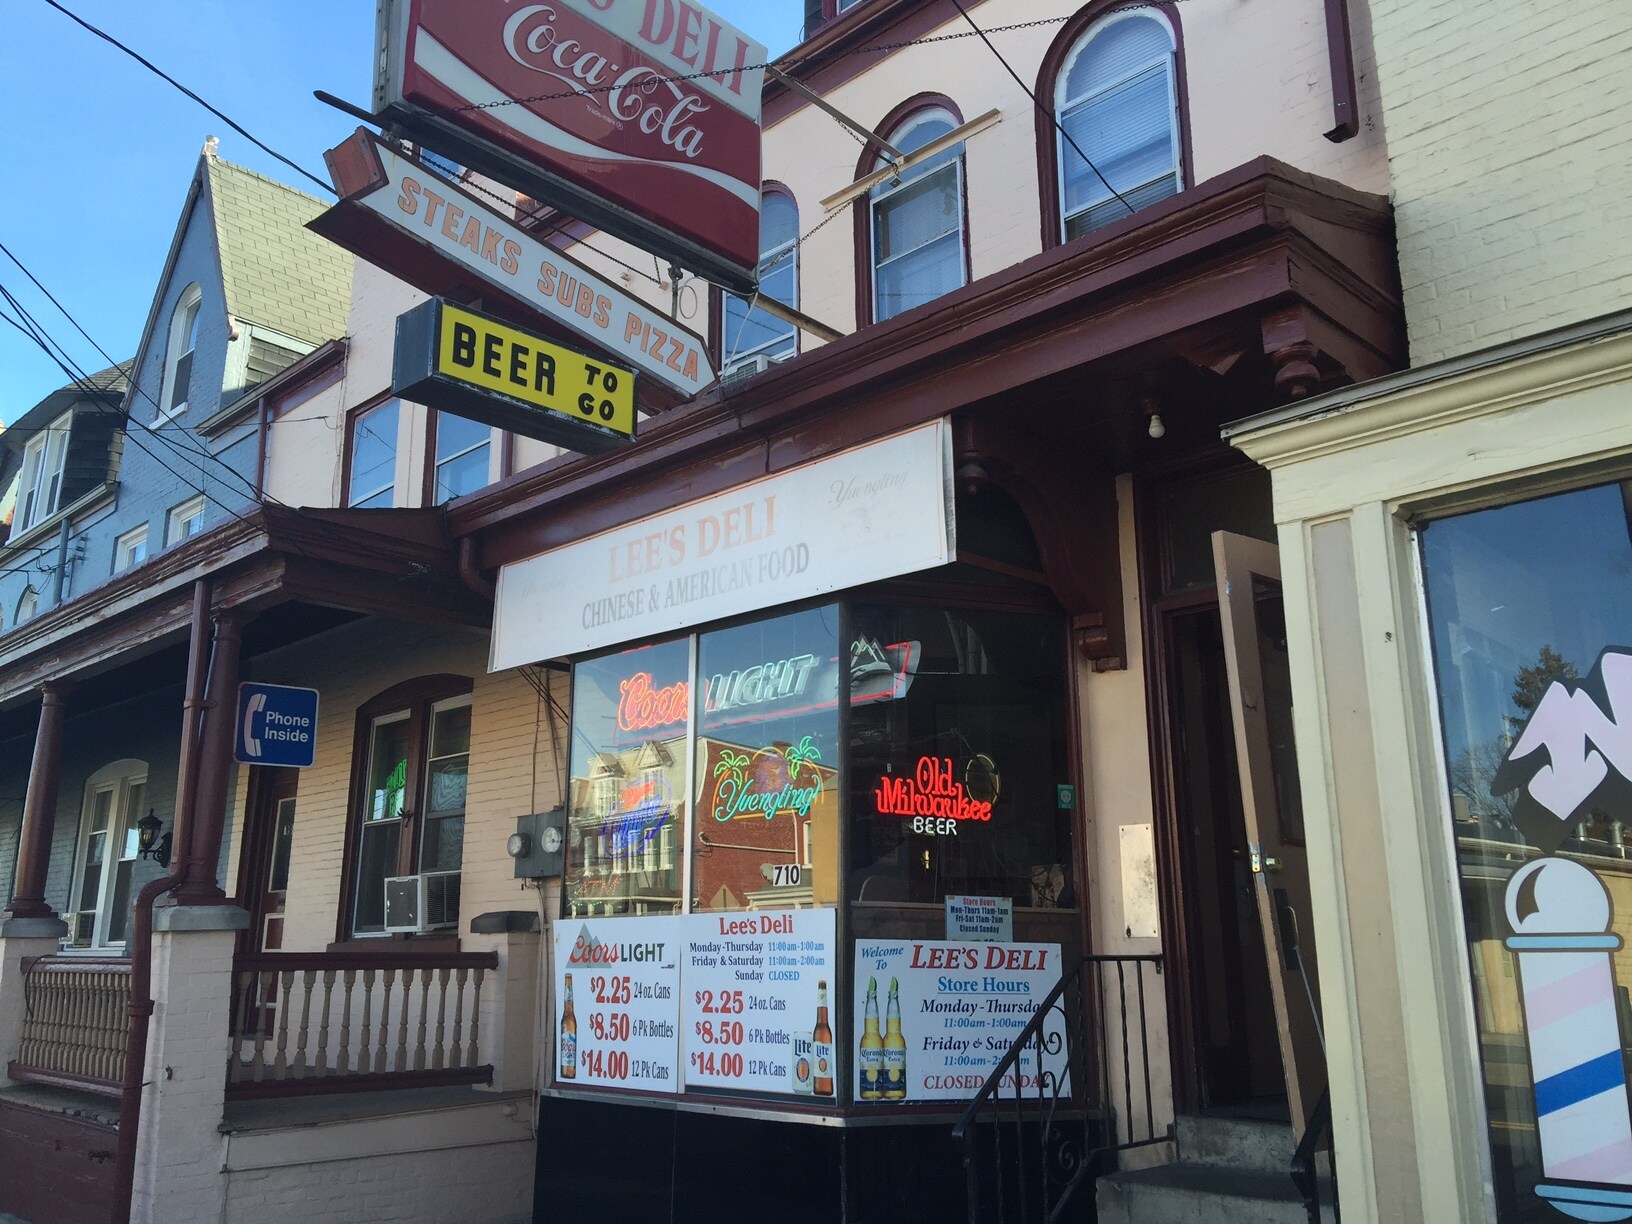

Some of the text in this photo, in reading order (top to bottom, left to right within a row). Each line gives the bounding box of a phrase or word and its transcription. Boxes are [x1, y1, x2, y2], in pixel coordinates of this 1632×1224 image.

[636, 0, 750, 97] DELI
[397, 176, 698, 382] STEAKS SUBS PIZZA
[452, 322, 556, 396] BEER
[584, 363, 618, 393] TO
[578, 393, 615, 421] GO
[608, 495, 777, 584] LEE'S DELI
[582, 588, 645, 630] CHINESE
[649, 584, 660, 614] &
[664, 557, 753, 609] AMERICAN
[758, 542, 809, 584] FOOD
[266, 711, 310, 727] Phone
[264, 726, 309, 743] Inside
[916, 756, 958, 796] Old
[715, 775, 822, 822] Yuengling
[875, 776, 991, 821] Milwaukee
[913, 816, 957, 836] BEER
[774, 865, 800, 886] 710
[963, 898, 978, 906] Store
[719, 914, 794, 935] Lee's Deli
[980, 925, 999, 933] Sunday
[569, 935, 665, 963] Coors LIGHT
[862, 946, 904, 959] Welcome
[909, 944, 1048, 971] LEE'S DELI
[692, 956, 718, 968] Friday
[720, 956, 727, 966] &
[728, 955, 764, 968] Saturday
[876, 959, 887, 970] To
[735, 970, 800, 983] Sunday CLOSED
[937, 976, 1030, 992] Store Hours
[590, 976, 631, 1004] $2.25
[633, 982, 642, 999] 24
[654, 982, 671, 999] Cans
[695, 990, 744, 1014] $2.25
[749, 995, 757, 1010] 24
[769, 996, 786, 1011] Cans
[920, 999, 1041, 1017] Monday-Thursda
[589, 1012, 674, 1042] $8.50 6 Pk Bottles
[695, 1020, 790, 1045] $8.50 6 Pk Bottles
[794, 1039, 811, 1057] Lite
[816, 1044, 829, 1057] Lite
[922, 1036, 1050, 1054] Friday & Satda
[581, 1049, 669, 1080] $14.00 12 Pk Cans
[691, 1051, 787, 1078] $14.00 12 Pk Cans
[924, 1074, 1050, 1089] CLOSED UNDA
